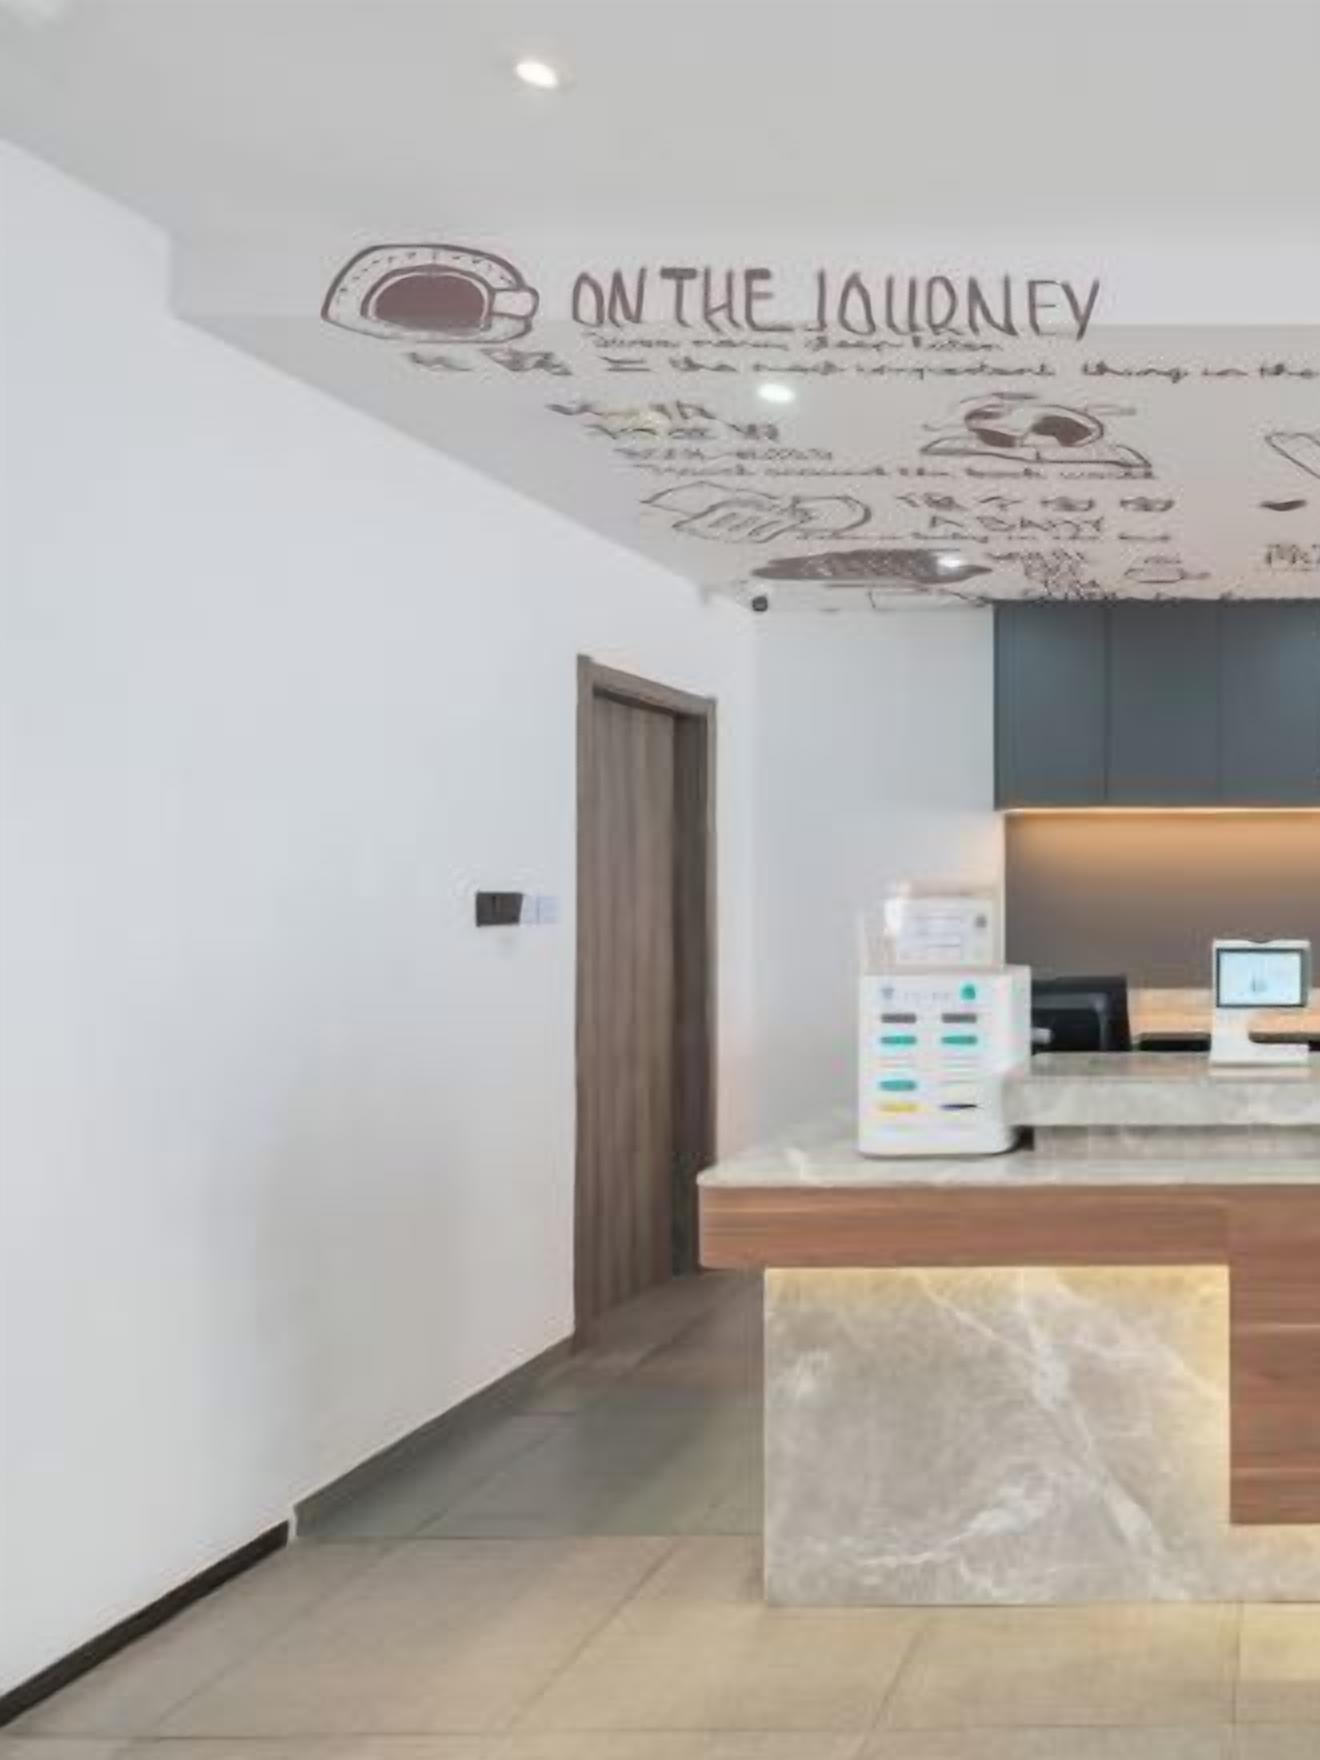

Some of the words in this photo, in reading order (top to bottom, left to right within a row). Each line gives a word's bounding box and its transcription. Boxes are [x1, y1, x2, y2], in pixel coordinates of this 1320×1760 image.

[571, 267, 649, 328] ON
[660, 267, 794, 333] THE
[804, 266, 1100, 340] JOURNEY
[1083, 361, 1188, 384] thing
